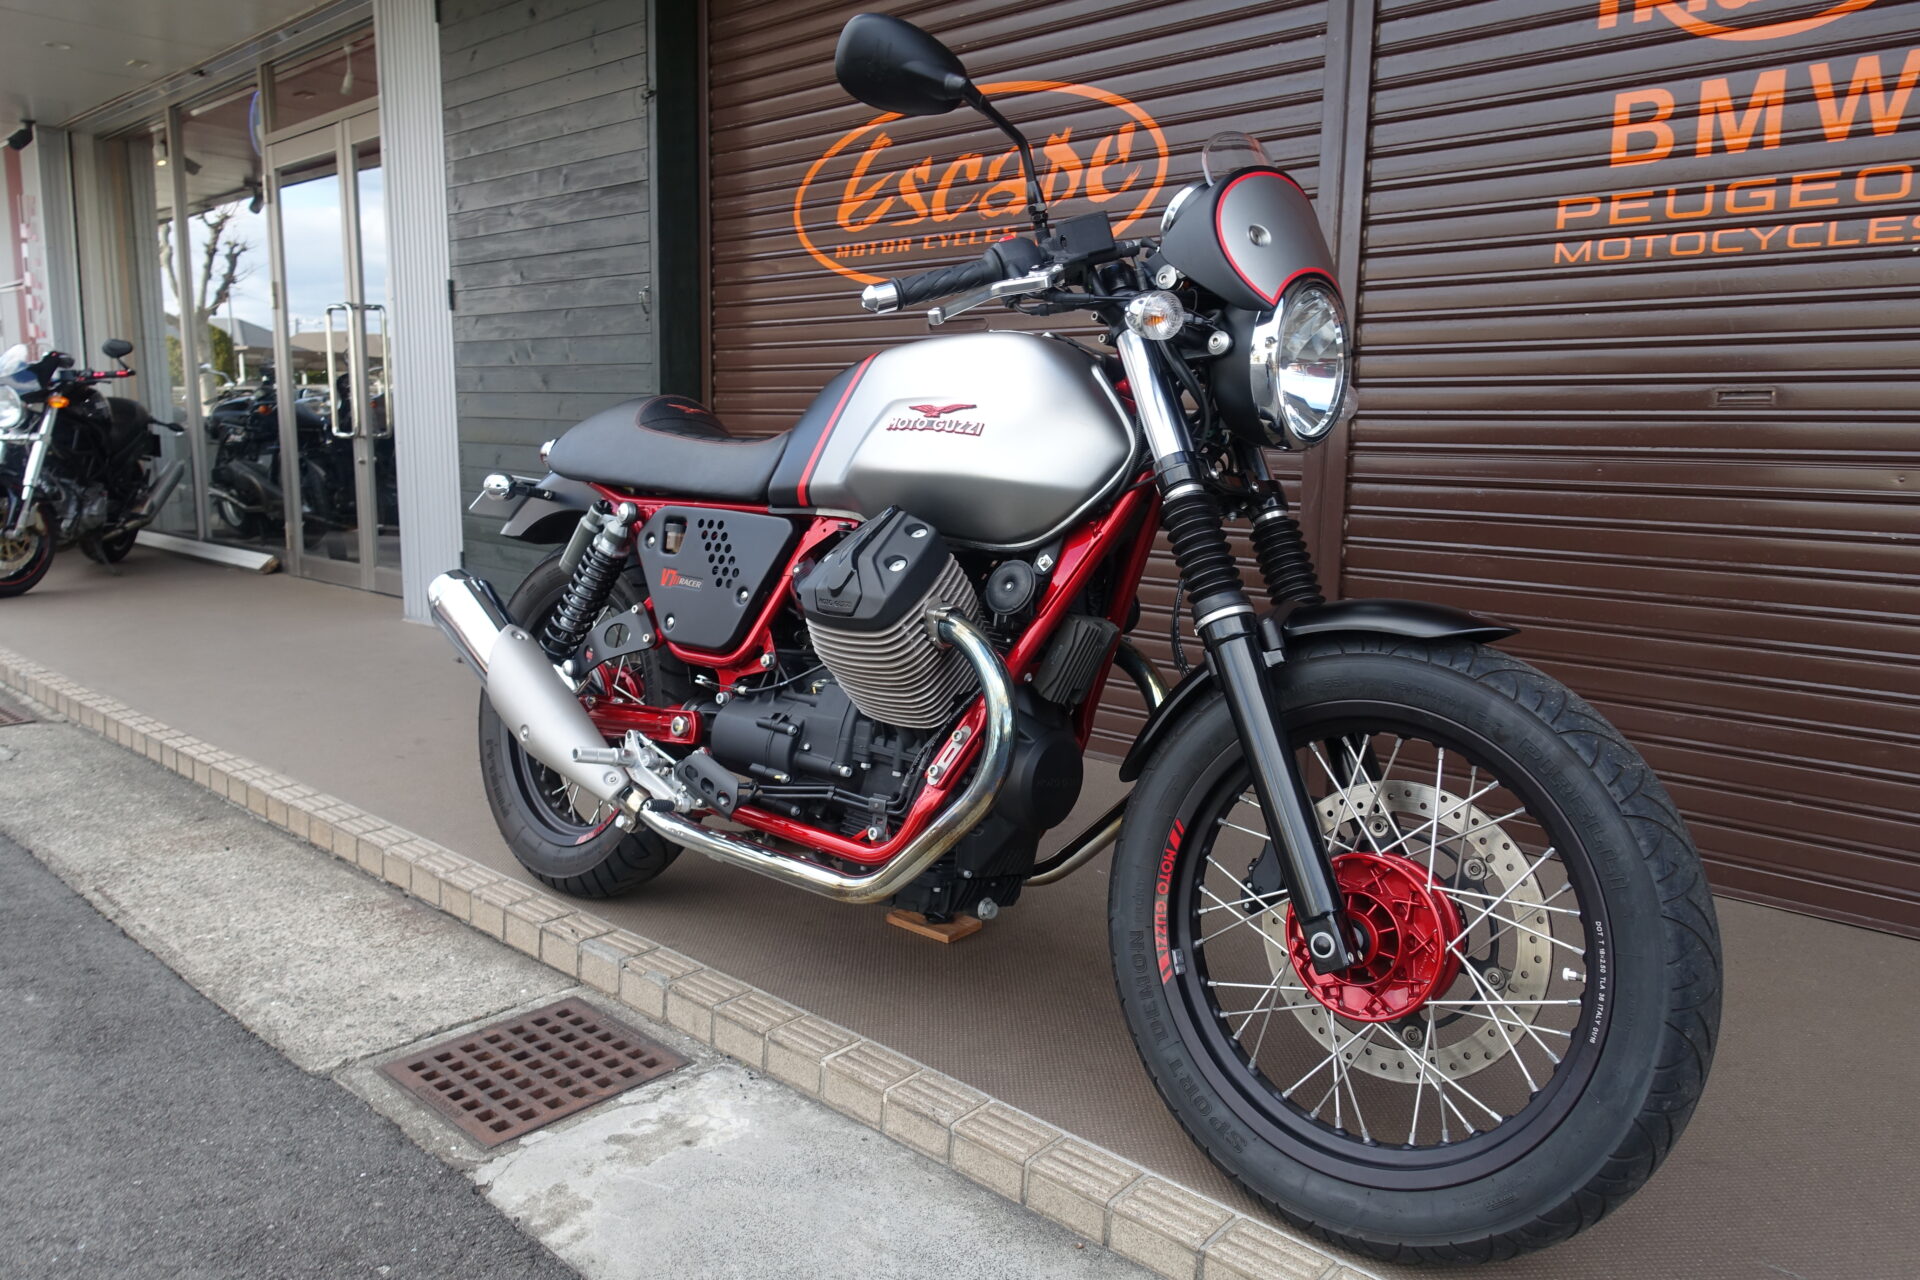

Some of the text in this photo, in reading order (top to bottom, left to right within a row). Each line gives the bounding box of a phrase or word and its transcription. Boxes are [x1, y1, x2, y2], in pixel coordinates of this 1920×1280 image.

[1610, 49, 1920, 167] BMW
[834, 237, 912, 258] MOTOR
[886, 418, 985, 436] MOTO GUZZI
[679, 576, 703, 589] RACER
[1155, 848, 1177, 952] MOTO GUZZI
[1595, 920, 1604, 937] DOT
[1594, 1003, 1604, 1026] ITALY
